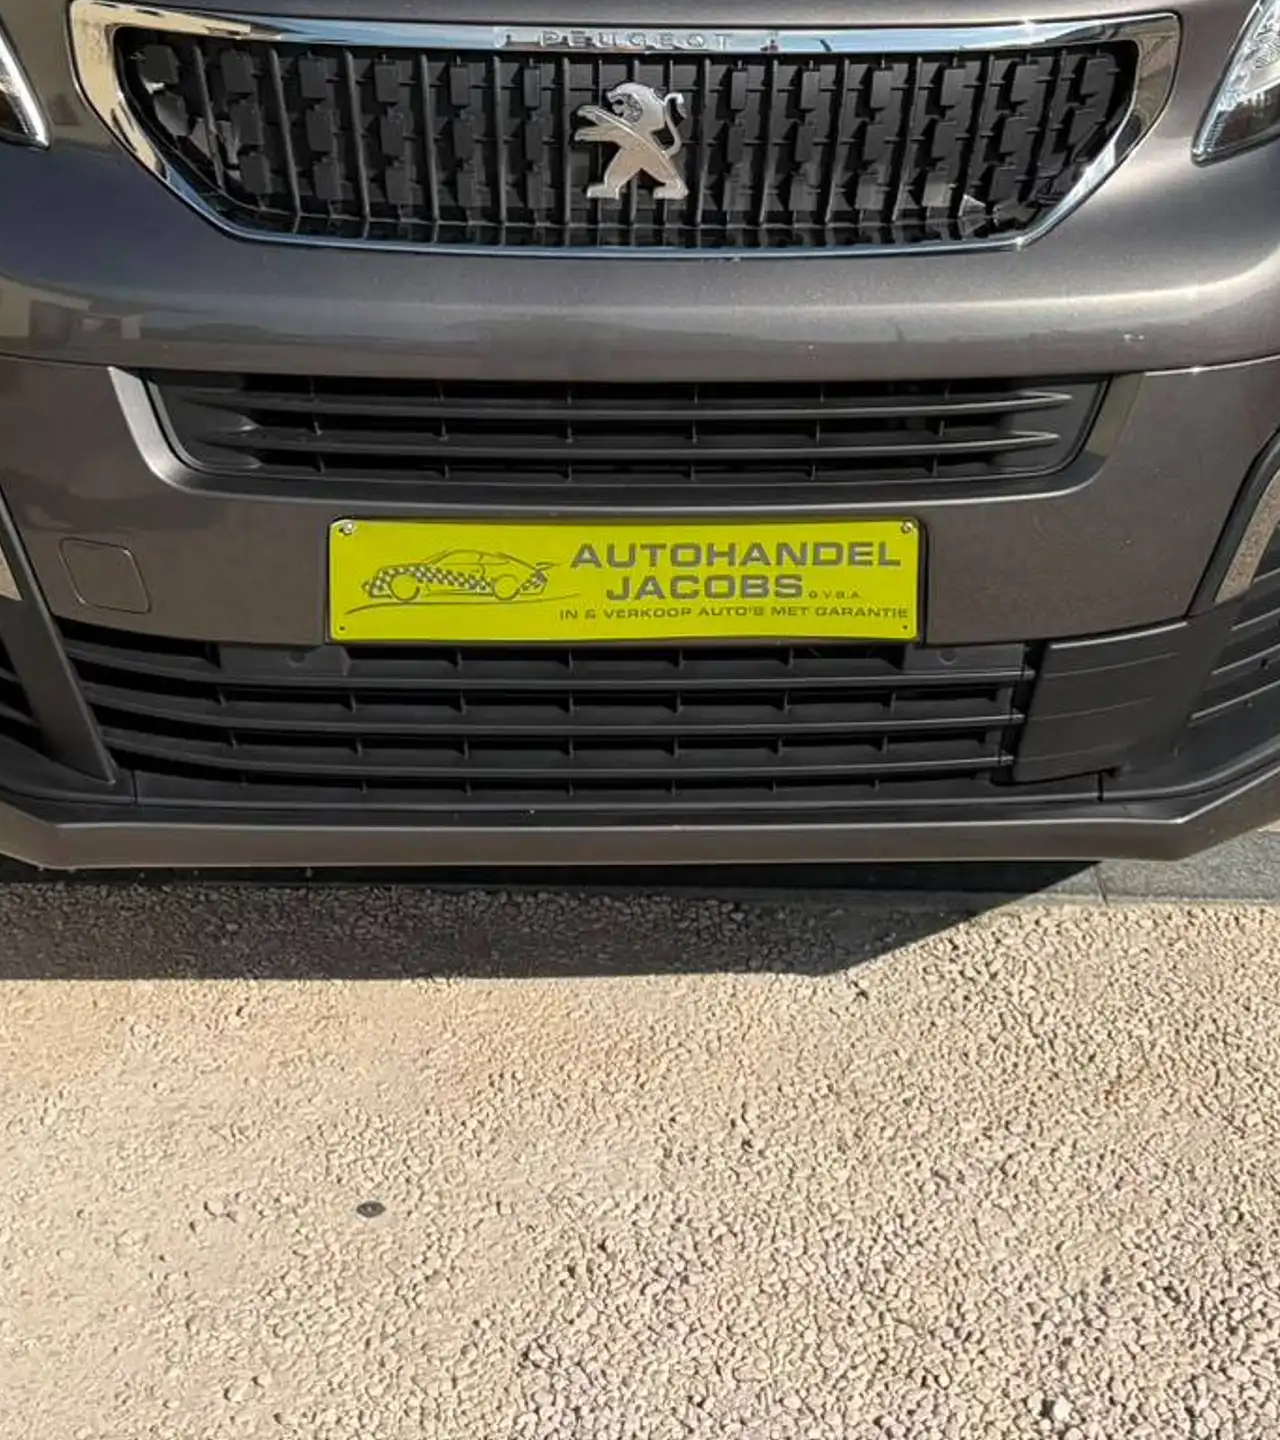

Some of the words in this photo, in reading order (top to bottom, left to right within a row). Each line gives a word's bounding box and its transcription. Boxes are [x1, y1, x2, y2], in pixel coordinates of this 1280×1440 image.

[539, 29, 733, 51] PEUGEOT
[570, 541, 902, 569] AUTOHANDEL
[606, 573, 804, 601] JACOBS
[560, 608, 578, 620] IN
[604, 606, 692, 620] VERKOOP
[771, 605, 812, 617] MET
[815, 606, 910, 619] GARANTIE
